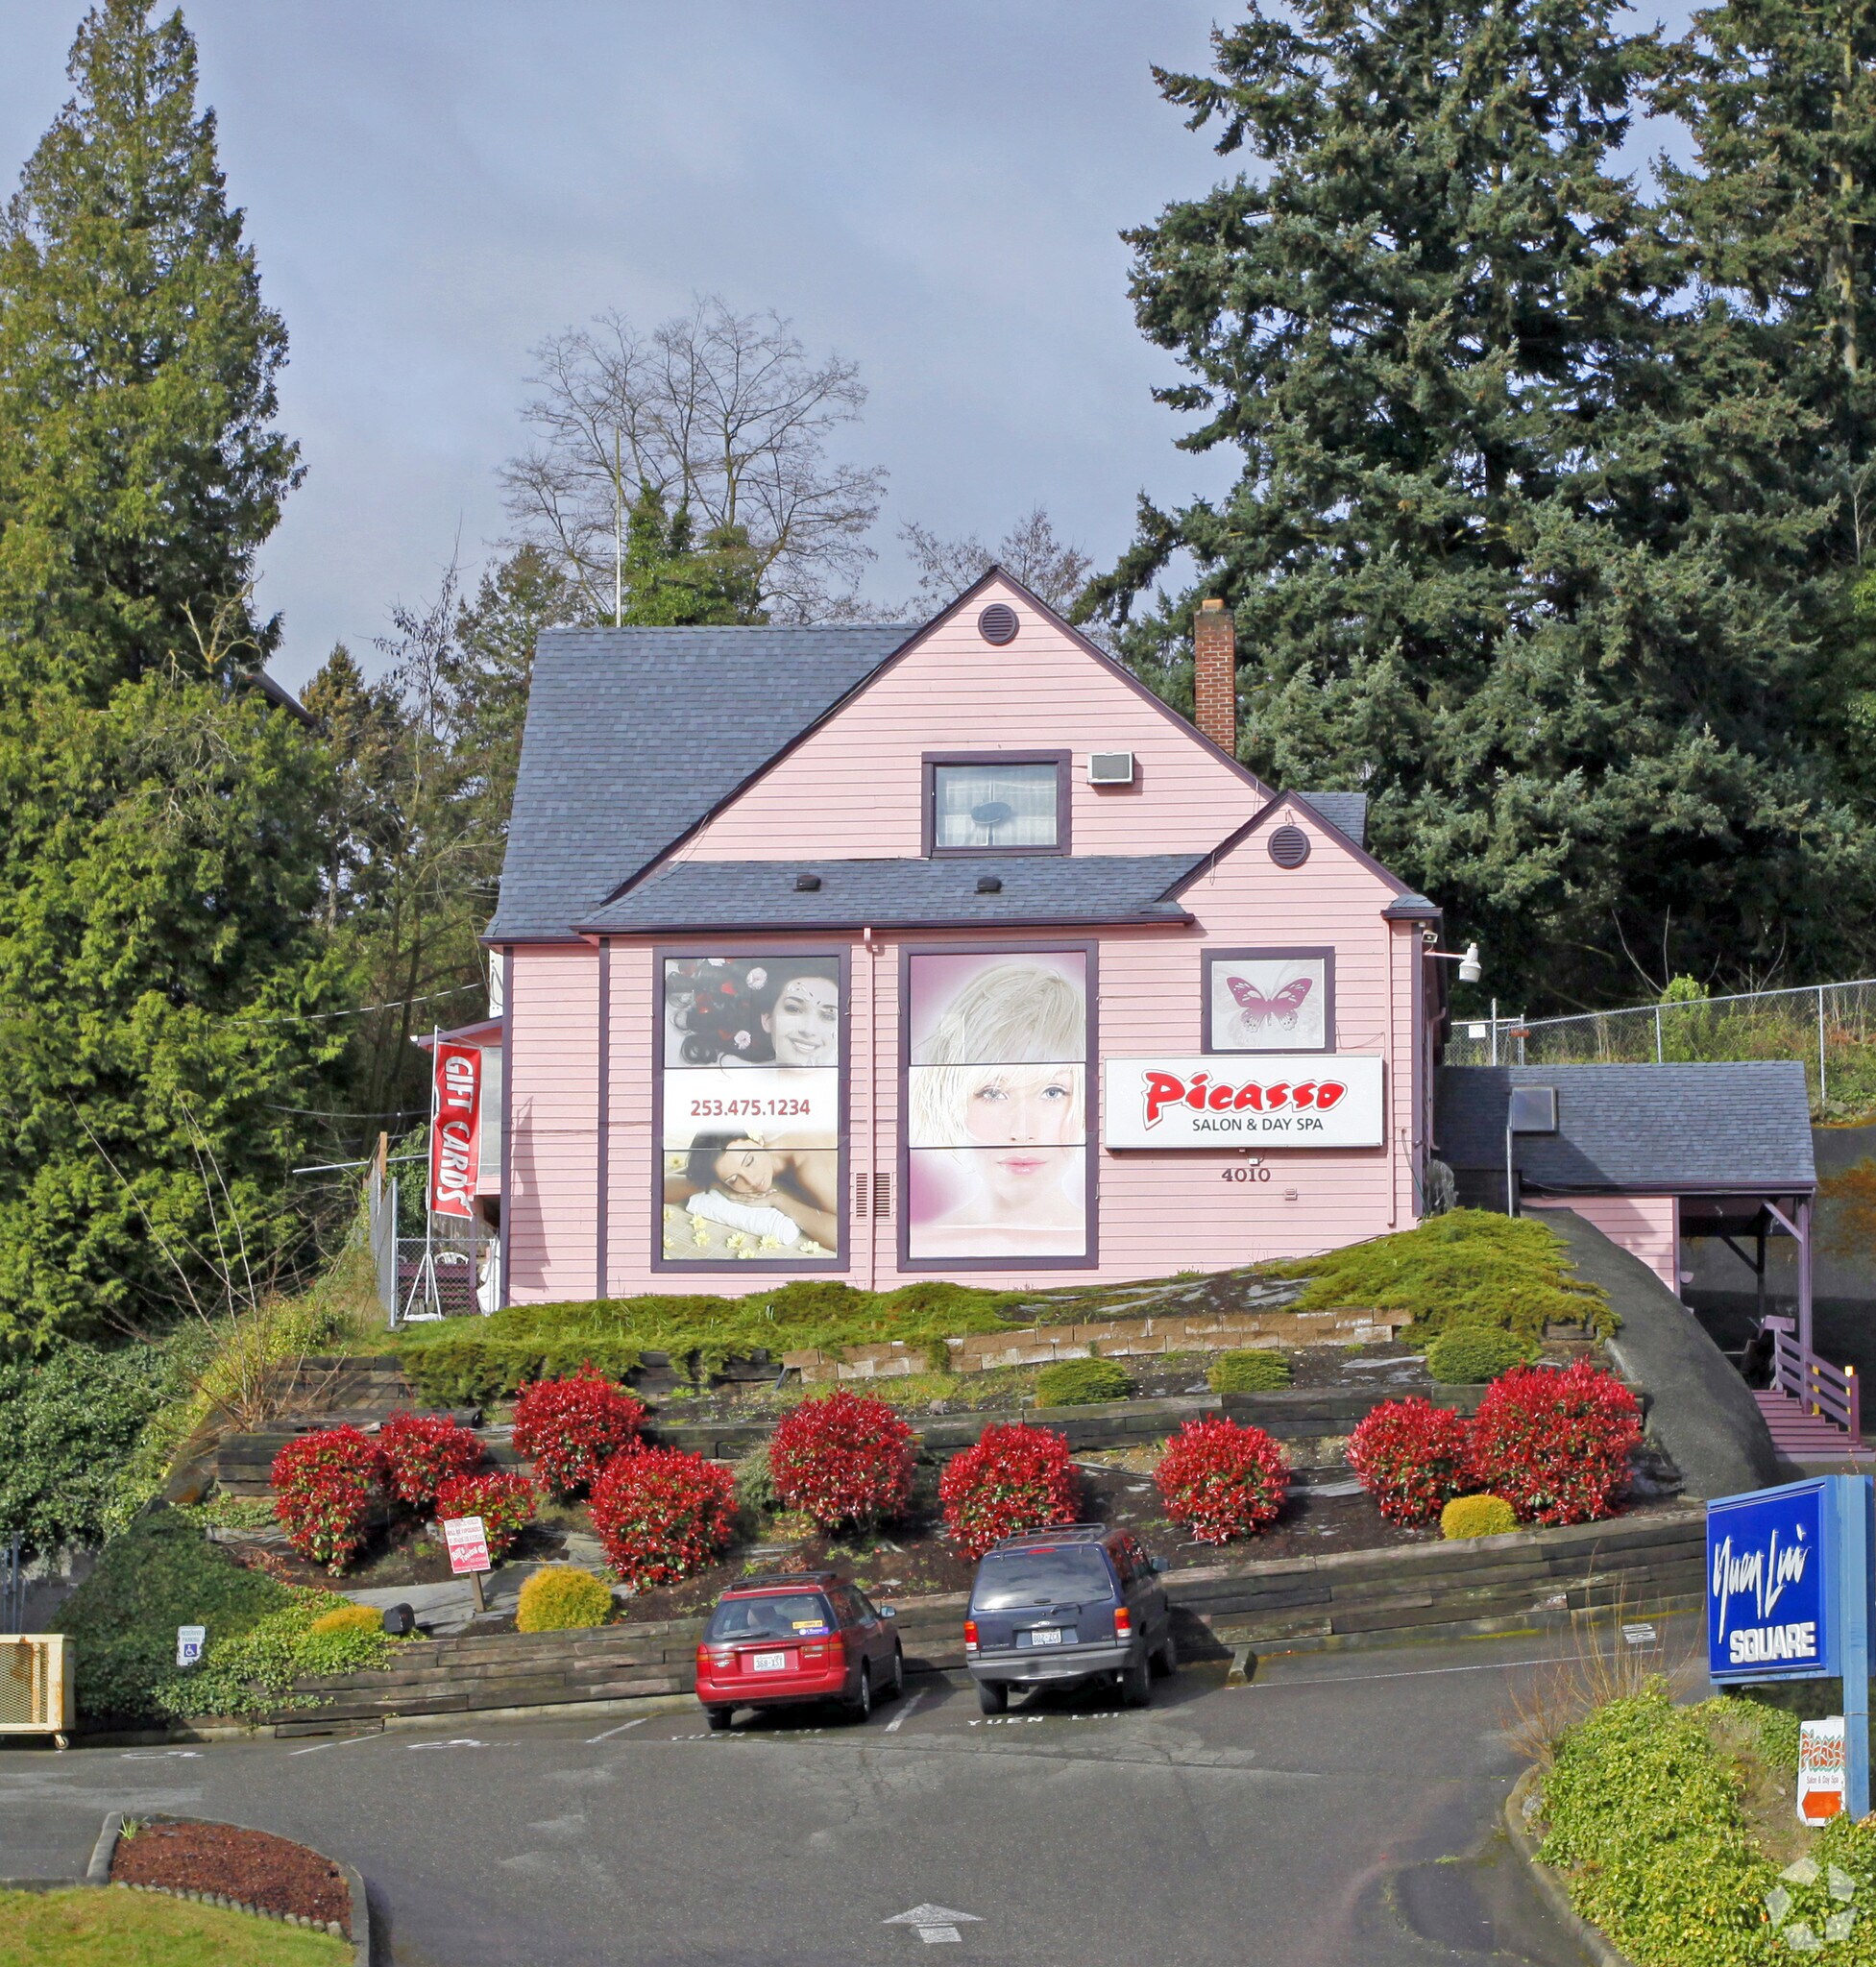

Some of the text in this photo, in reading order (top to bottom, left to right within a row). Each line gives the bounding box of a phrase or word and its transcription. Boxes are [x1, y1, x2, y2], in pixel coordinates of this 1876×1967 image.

[1143, 1069, 1346, 1126] Picasso
[691, 1099, 811, 1116] 253.475.1234
[1192, 1117, 1324, 1131] SALON & DAY SPA
[436, 1056, 475, 1216] GIFT CARDS
[1221, 1168, 1271, 1182] 4010
[1729, 1621, 1816, 1663] SQUARE
[967, 1716, 1044, 1726] YUEN
